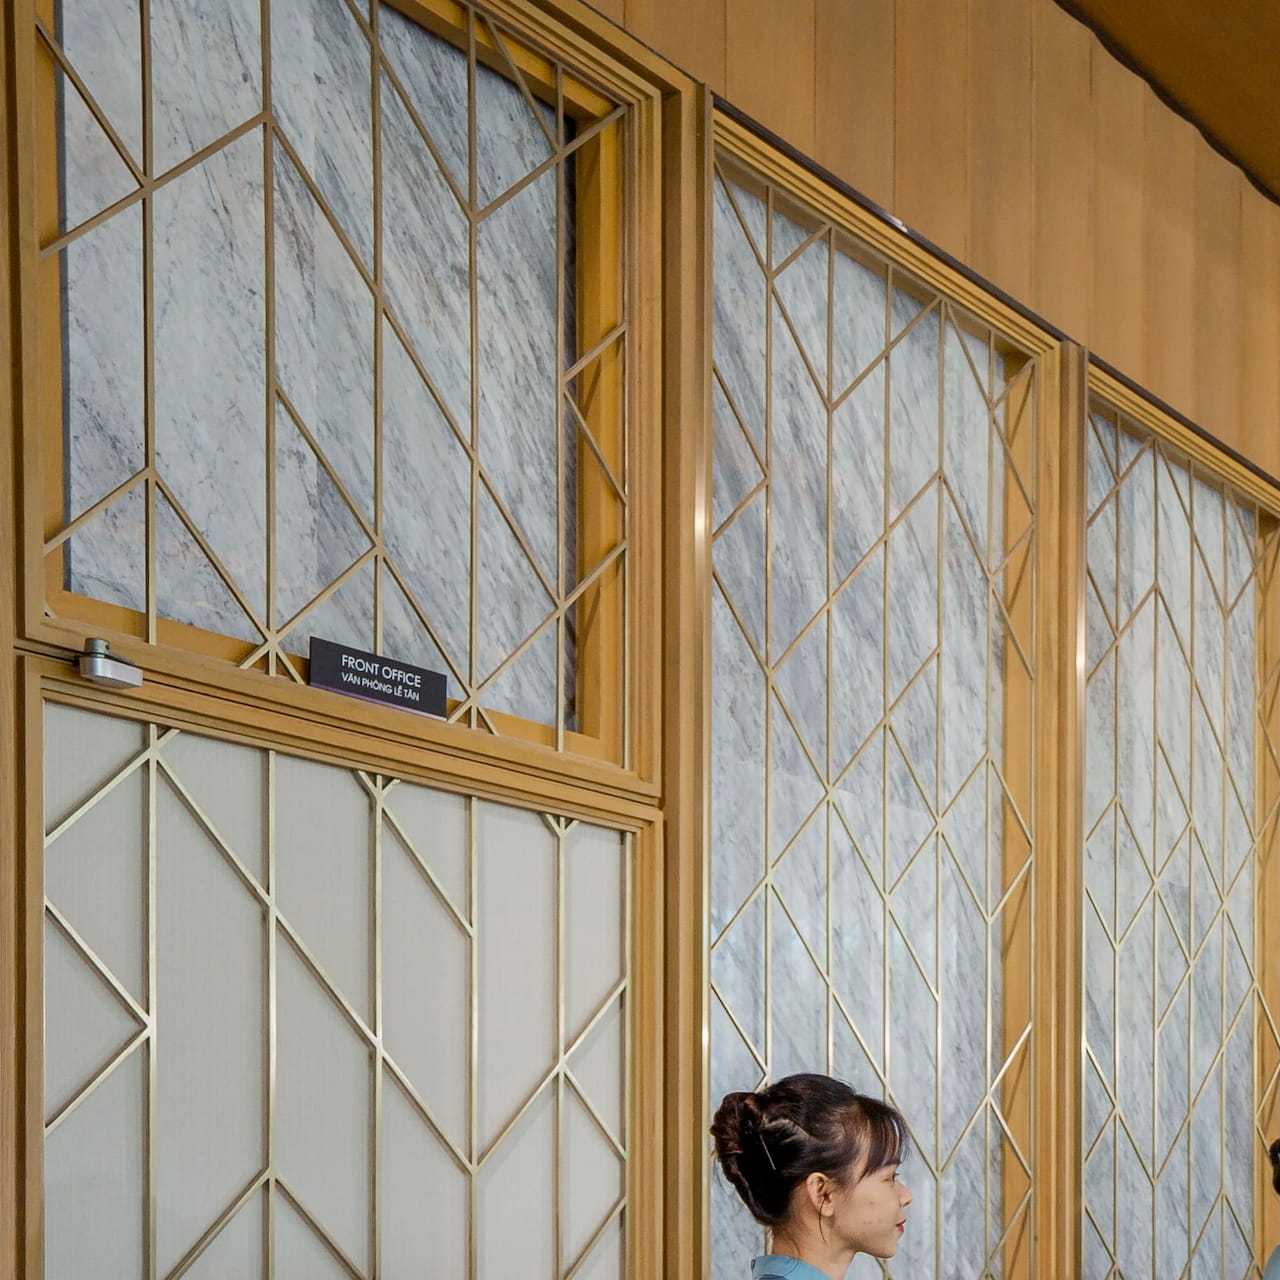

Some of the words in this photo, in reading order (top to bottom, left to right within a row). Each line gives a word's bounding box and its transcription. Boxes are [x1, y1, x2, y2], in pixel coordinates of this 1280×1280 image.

[341, 654, 380, 676] FRONT
[381, 666, 422, 688] OFFICE
[341, 671, 361, 686] VĂN
[403, 688, 420, 701] TÂN
